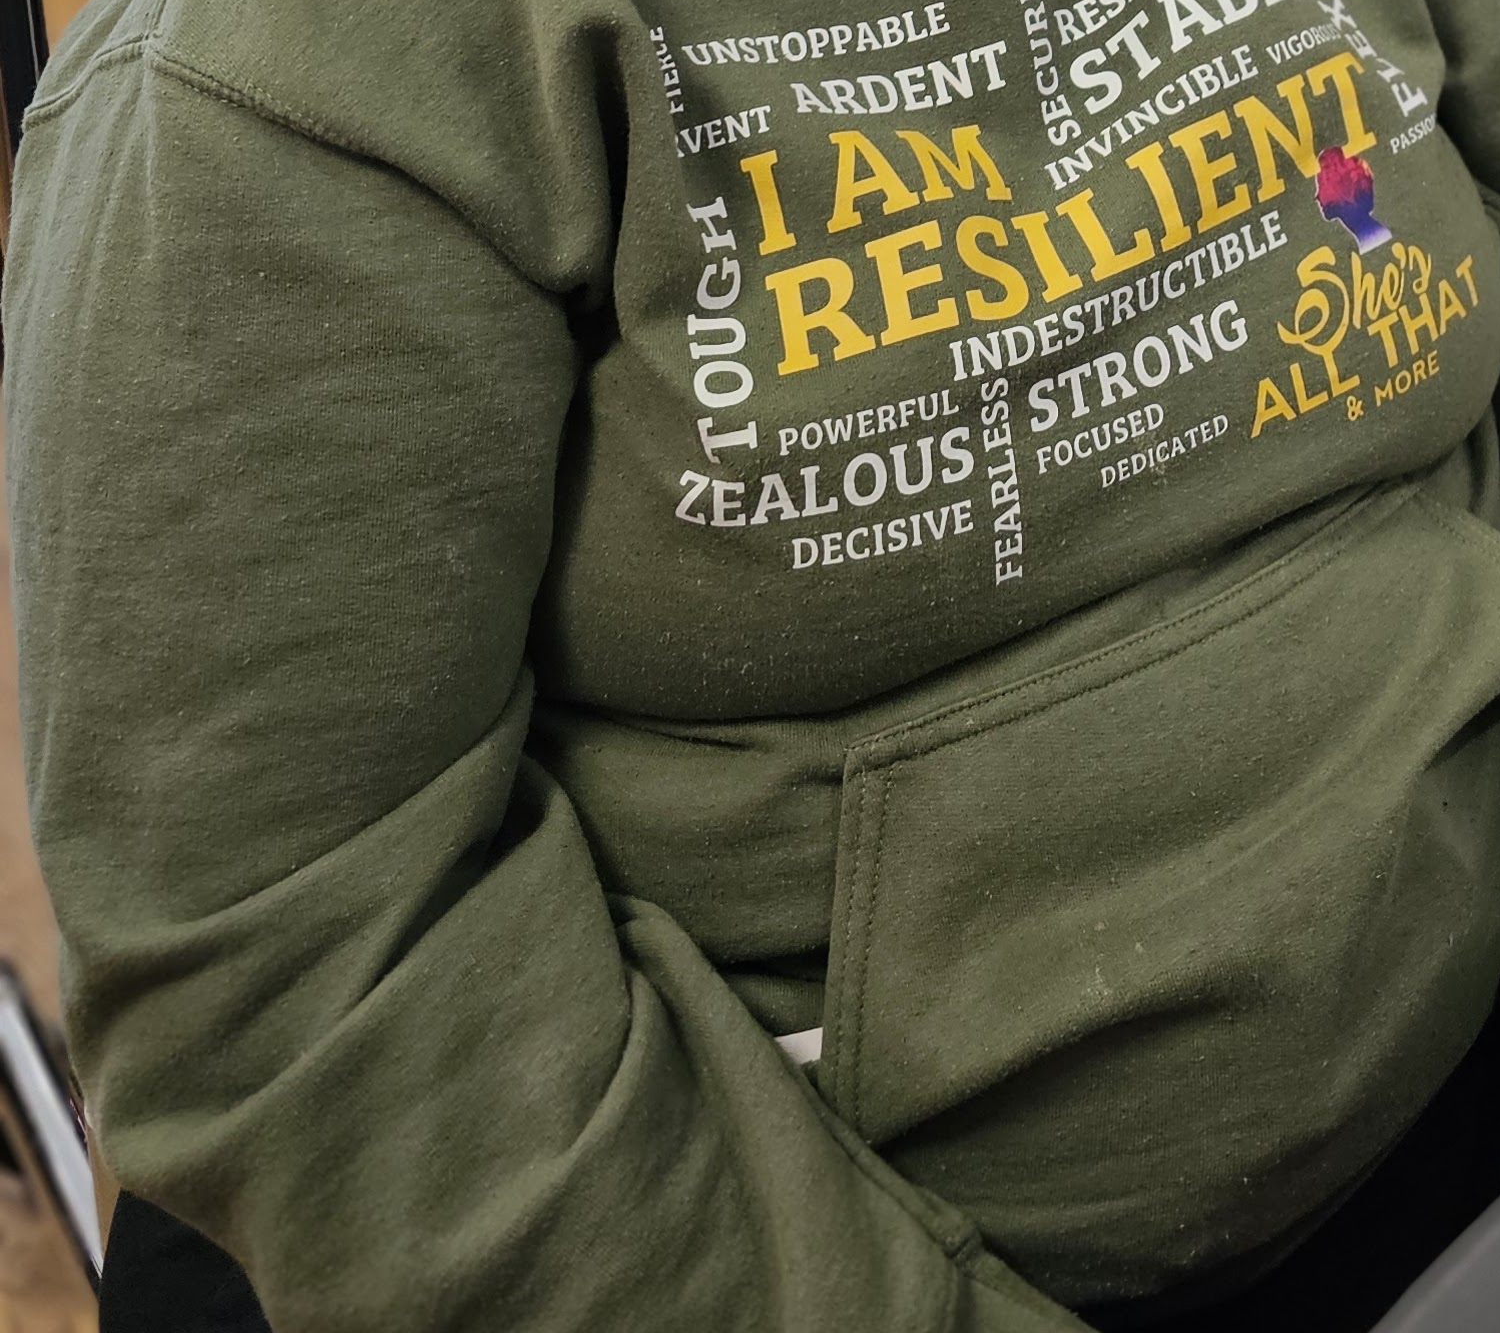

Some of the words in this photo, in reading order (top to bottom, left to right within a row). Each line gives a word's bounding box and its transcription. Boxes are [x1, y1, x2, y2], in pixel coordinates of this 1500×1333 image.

[681, 1, 952, 65] UNSTOPPABLE
[789, 40, 1007, 115] ARDENT
[1042, 43, 1259, 191] INVINCIBLE
[740, 150, 797, 256] I
[826, 124, 1012, 234] AM
[764, 51, 1378, 376] RESILIENT
[686, 196, 758, 464] TOUGH
[948, 210, 1288, 382] INDESTRUCTIBLE
[1251, 354, 1361, 437] ALL
[1366, 254, 1479, 369] THAT
[1277, 241, 1432, 356] She's
[777, 388, 960, 456] POWERFUL
[1028, 299, 1249, 433] STRONG
[1346, 395, 1364, 422] &
[1374, 350, 1440, 408] MORE
[675, 426, 975, 527] ZEALOUS
[980, 377, 1023, 587] FEARLESS
[1036, 403, 1164, 475] FOCUSED
[1100, 414, 1229, 488] DEDICATED
[791, 499, 974, 570] DECISIVE
